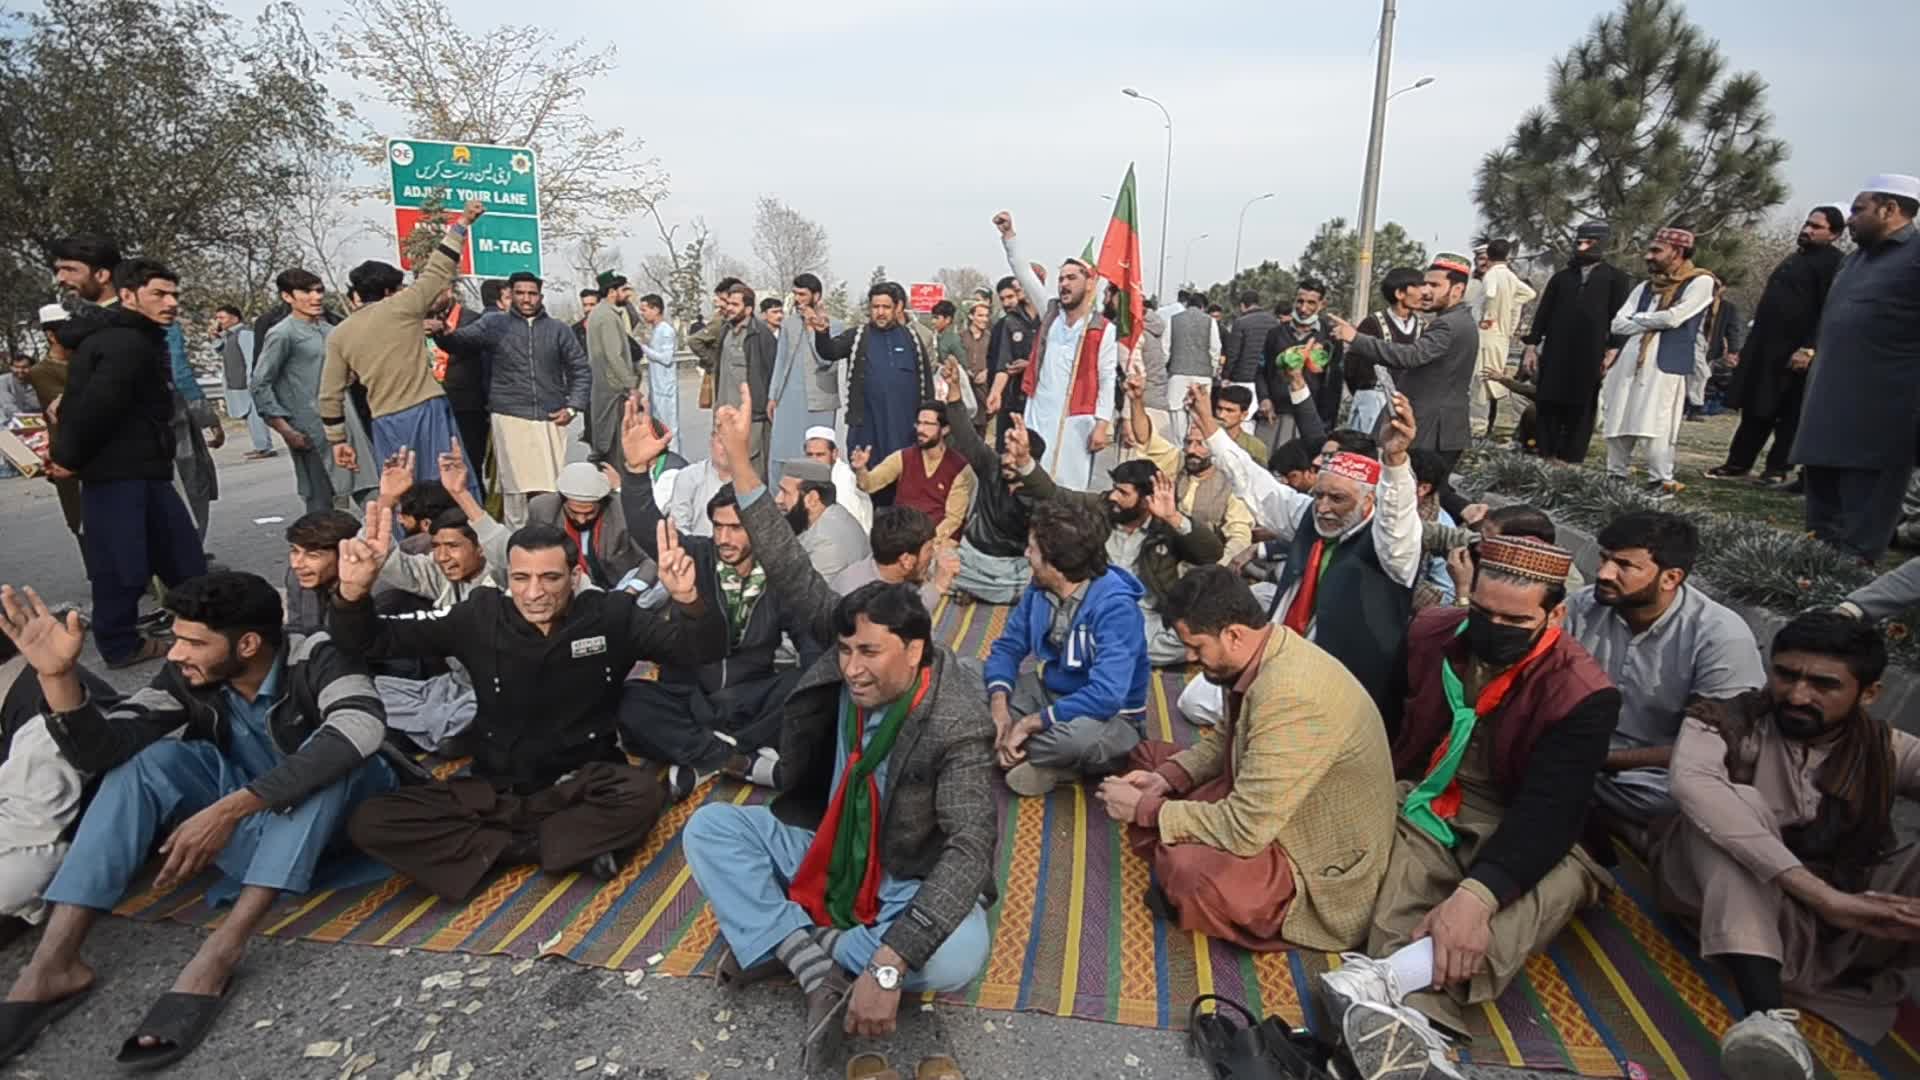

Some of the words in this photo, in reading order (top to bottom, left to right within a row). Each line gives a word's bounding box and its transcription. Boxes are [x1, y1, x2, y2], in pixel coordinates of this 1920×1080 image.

[416, 160, 446, 180] کریں
[440, 169, 475, 181] درست
[456, 188, 492, 203] YOUR
[493, 191, 528, 206] LANE
[478, 238, 533, 254] M-TAG
